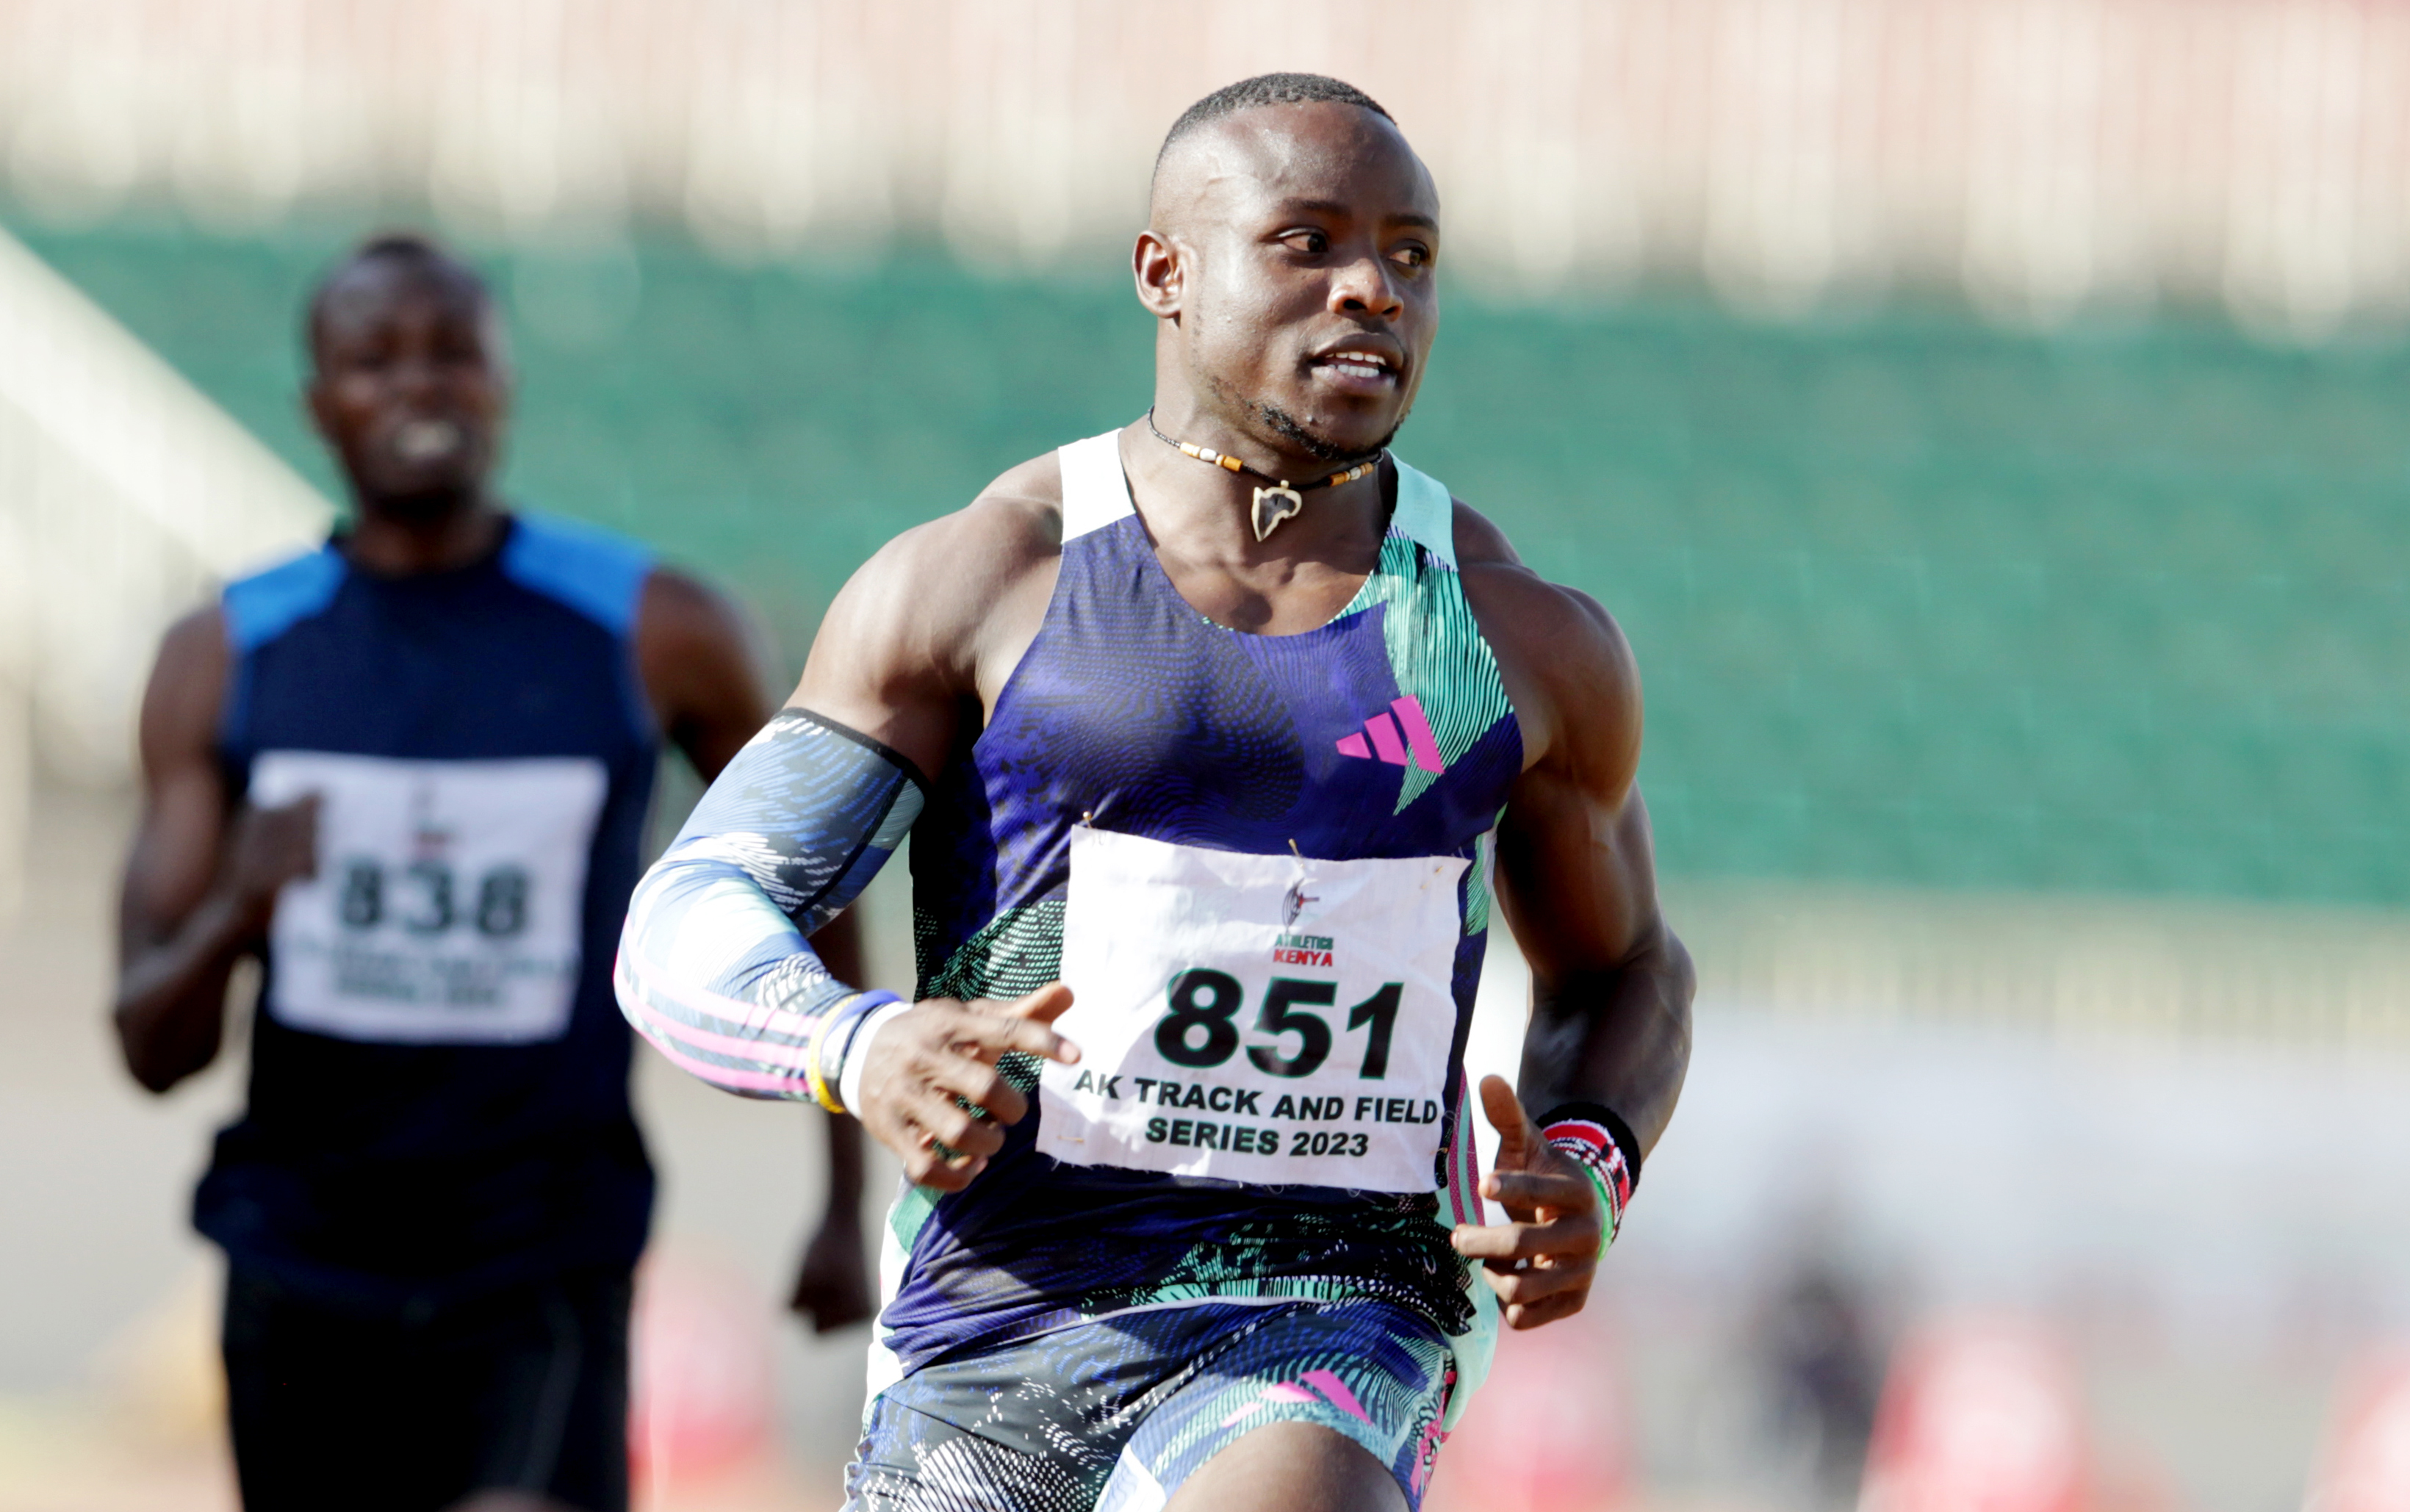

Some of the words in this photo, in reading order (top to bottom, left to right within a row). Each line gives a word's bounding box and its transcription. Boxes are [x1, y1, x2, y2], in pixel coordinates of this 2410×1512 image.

[339, 857, 530, 937] 838
[1273, 948, 1333, 967] KENYA
[1275, 934, 1334, 950] ATHLETICS
[1154, 968, 1404, 1080] 851
[1073, 1070, 1123, 1099] AK
[1135, 1078, 1262, 1115] TRACK
[1271, 1095, 1344, 1121] AND
[1355, 1098, 1437, 1124] FIELD
[1145, 1118, 1279, 1155] SERIES
[1289, 1131, 1368, 1156] 2023
